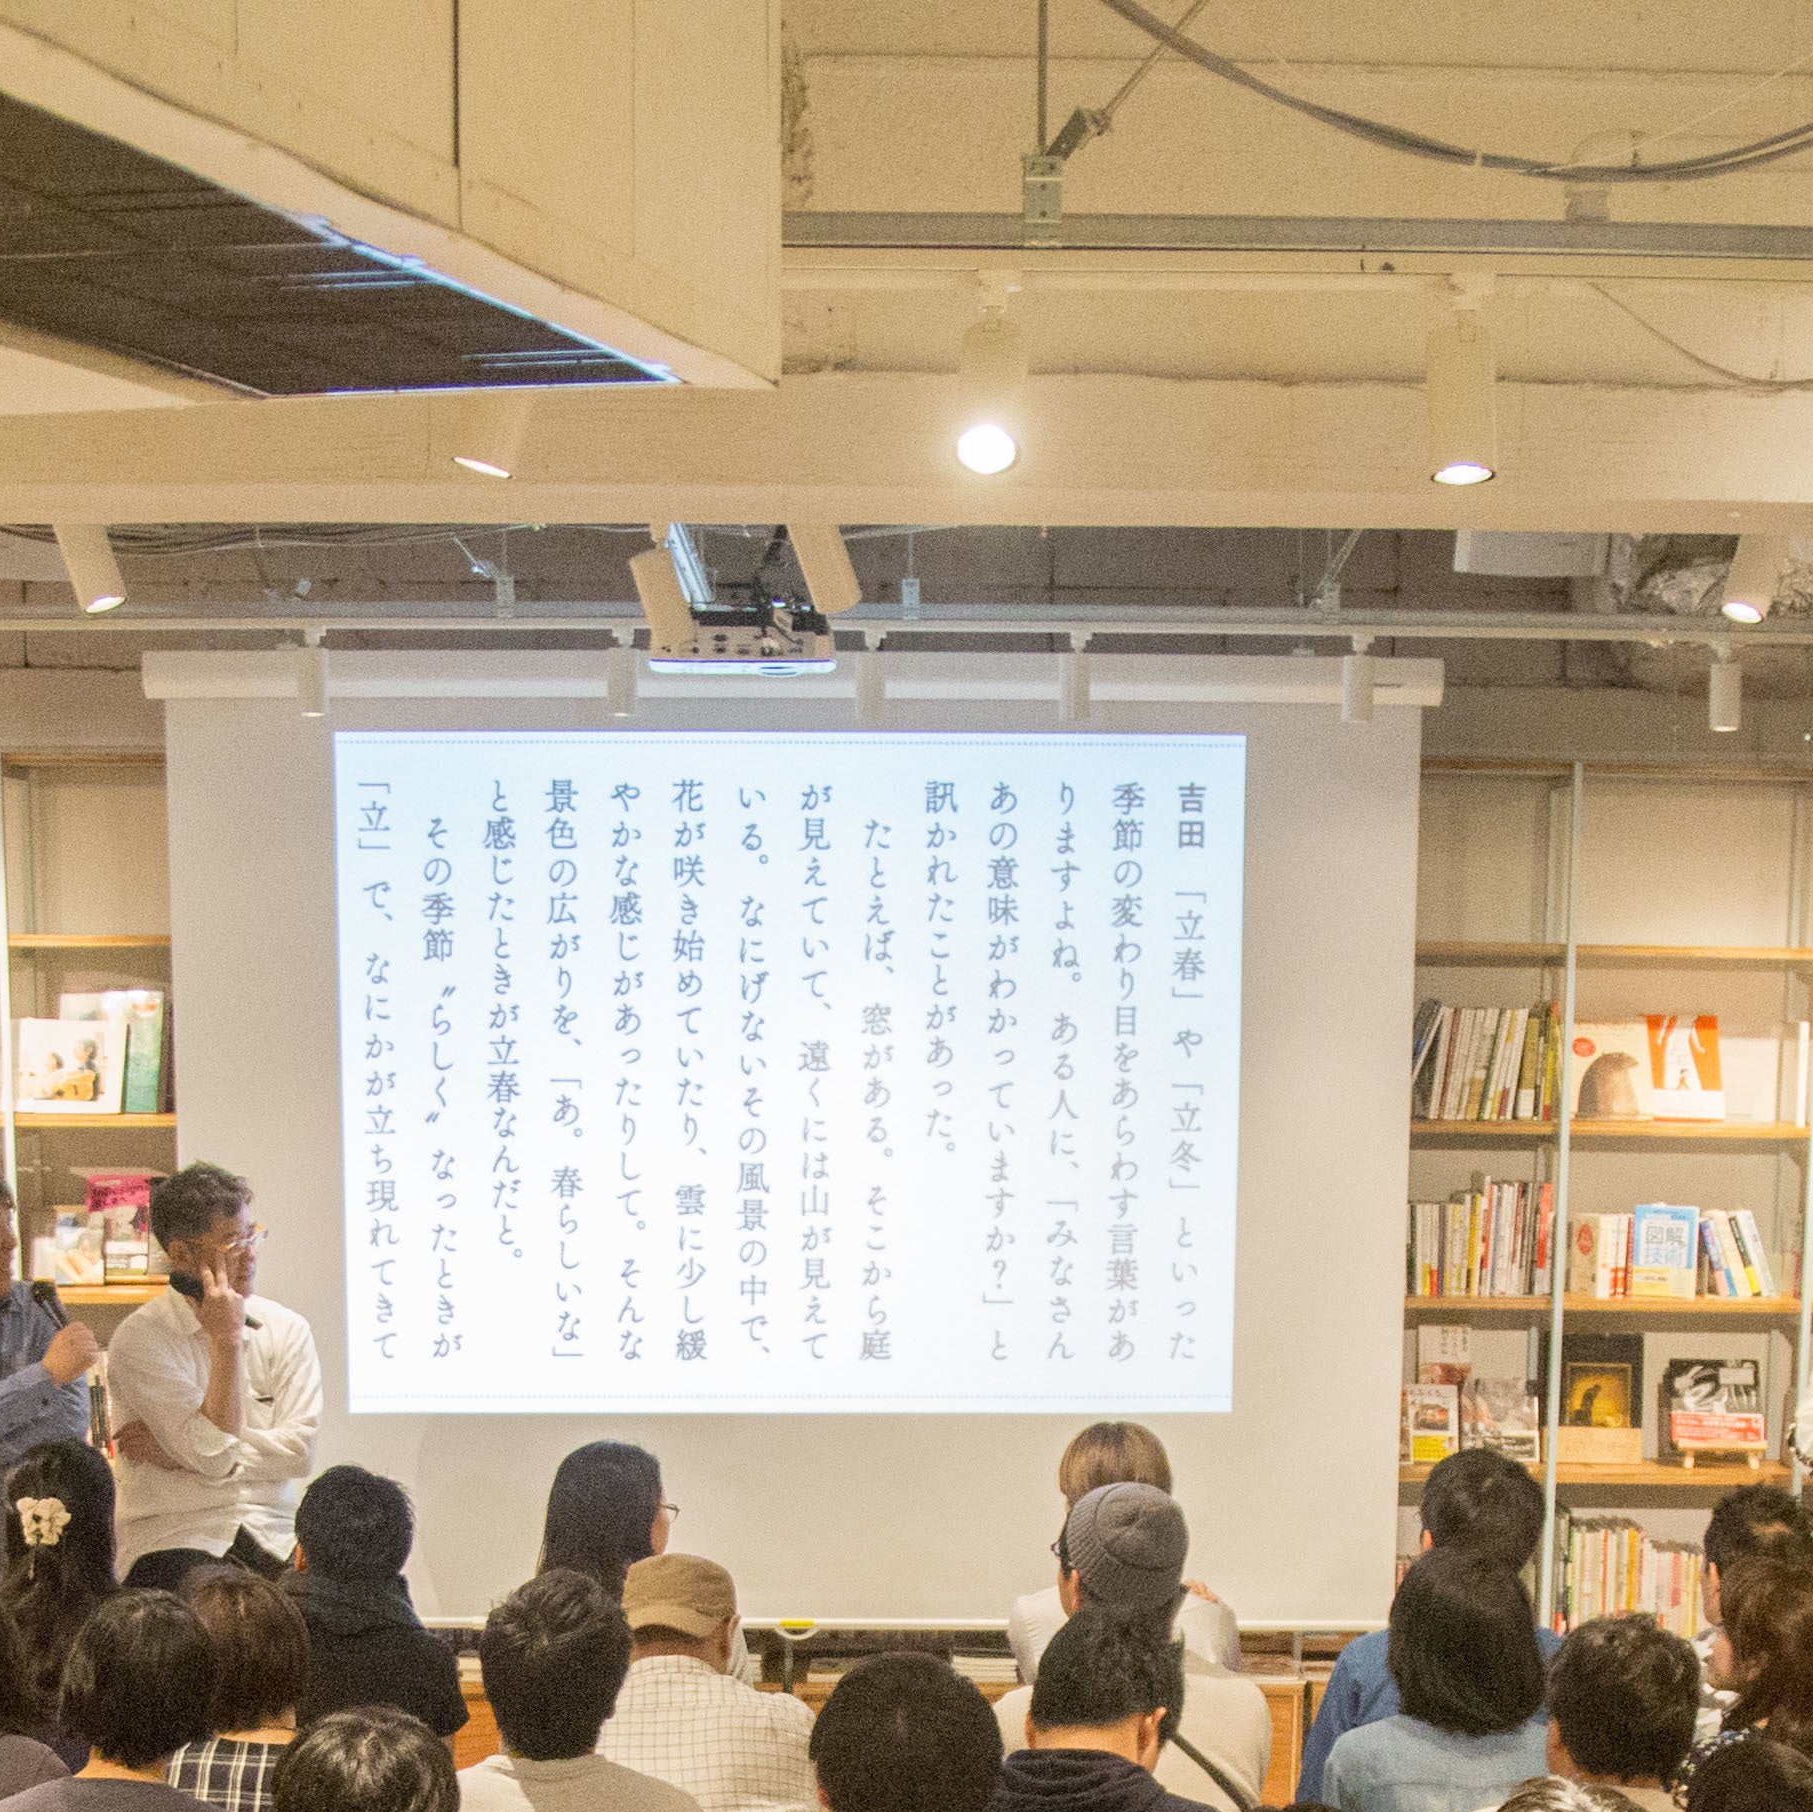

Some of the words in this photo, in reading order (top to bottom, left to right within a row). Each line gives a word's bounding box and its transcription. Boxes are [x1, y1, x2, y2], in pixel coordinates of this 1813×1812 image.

[358, 781, 399, 1360] 「立」で、なにかが立ち現れてきて
[483, 780, 523, 1258] と感じたときが立春なんだと。
[610, 782, 645, 1361] やかな感じがあったりして。そんな
[673, 779, 707, 1361] 花が咲き始めていたり、雲に少し緩
[737, 786, 770, 1354] いる。なにげないその風景の中で、
[798, 783, 832, 1360] が見えていて、遠くには山が見えて
[860, 819, 895, 1360] たとえば、窓がある。そこから庭
[925, 780, 958, 1152] 訊かれたことがあった。
[1108, 781, 1145, 1361] 季節の変わり目をあらわす言葉があ
[1176, 783, 1207, 850] 吉田
[1645, 1226, 1686, 1248] 図解
